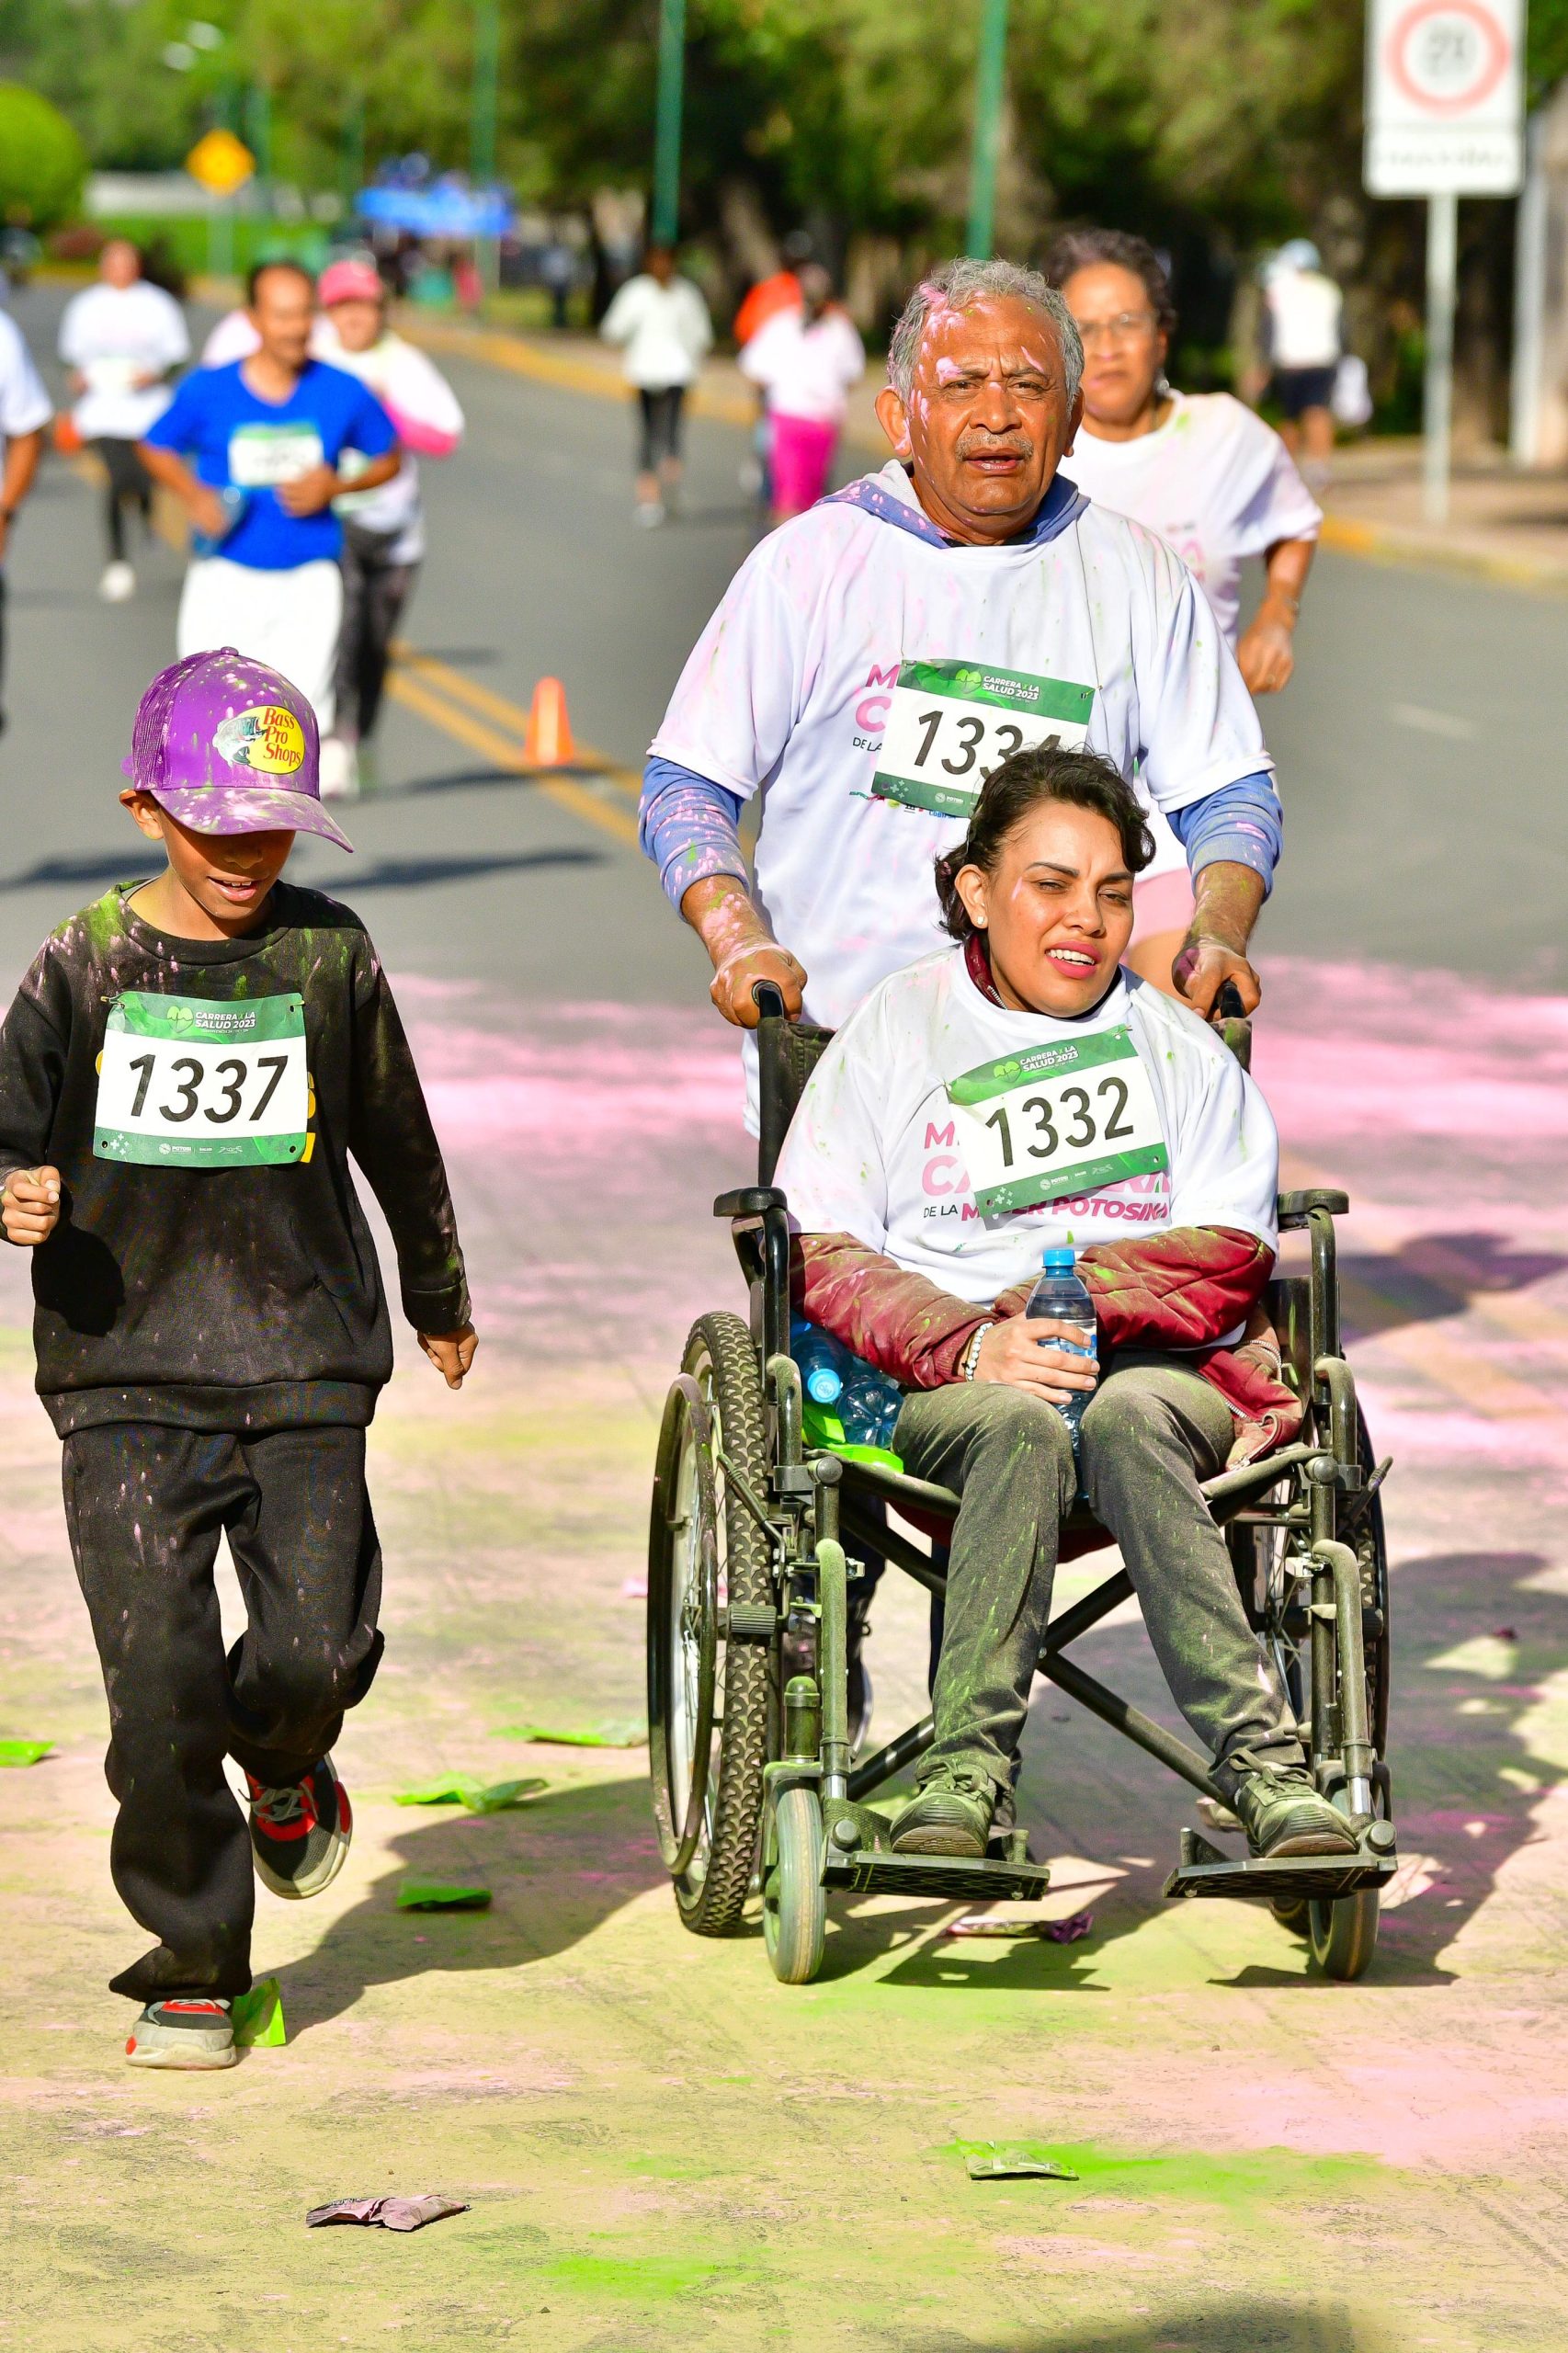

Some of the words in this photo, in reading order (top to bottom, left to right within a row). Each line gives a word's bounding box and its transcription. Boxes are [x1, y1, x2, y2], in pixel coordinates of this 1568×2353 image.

[983, 676, 1021, 688] CARRERA
[983, 683, 1015, 696] SALUD
[1016, 689, 1039, 700] 2023
[264, 708, 295, 729] Bass
[264, 726, 288, 744] Pro
[853, 737, 868, 749] DE
[914, 710, 1062, 780] 133
[264, 743, 301, 767] Shops
[195, 1012, 238, 1020] CARRERA
[195, 1019, 232, 1029] SALUD
[233, 1019, 256, 1029] 2023
[1020, 1050, 1059, 1065] CARRERA
[1064, 1045, 1076, 1053] LA
[1022, 1058, 1055, 1072] SALUD
[1056, 1051, 1079, 1063] 2023
[129, 1053, 289, 1124] 1337
[984, 1076, 1134, 1167] 1332
[924, 1206, 941, 1219] DE
[941, 1205, 959, 1216] LA
